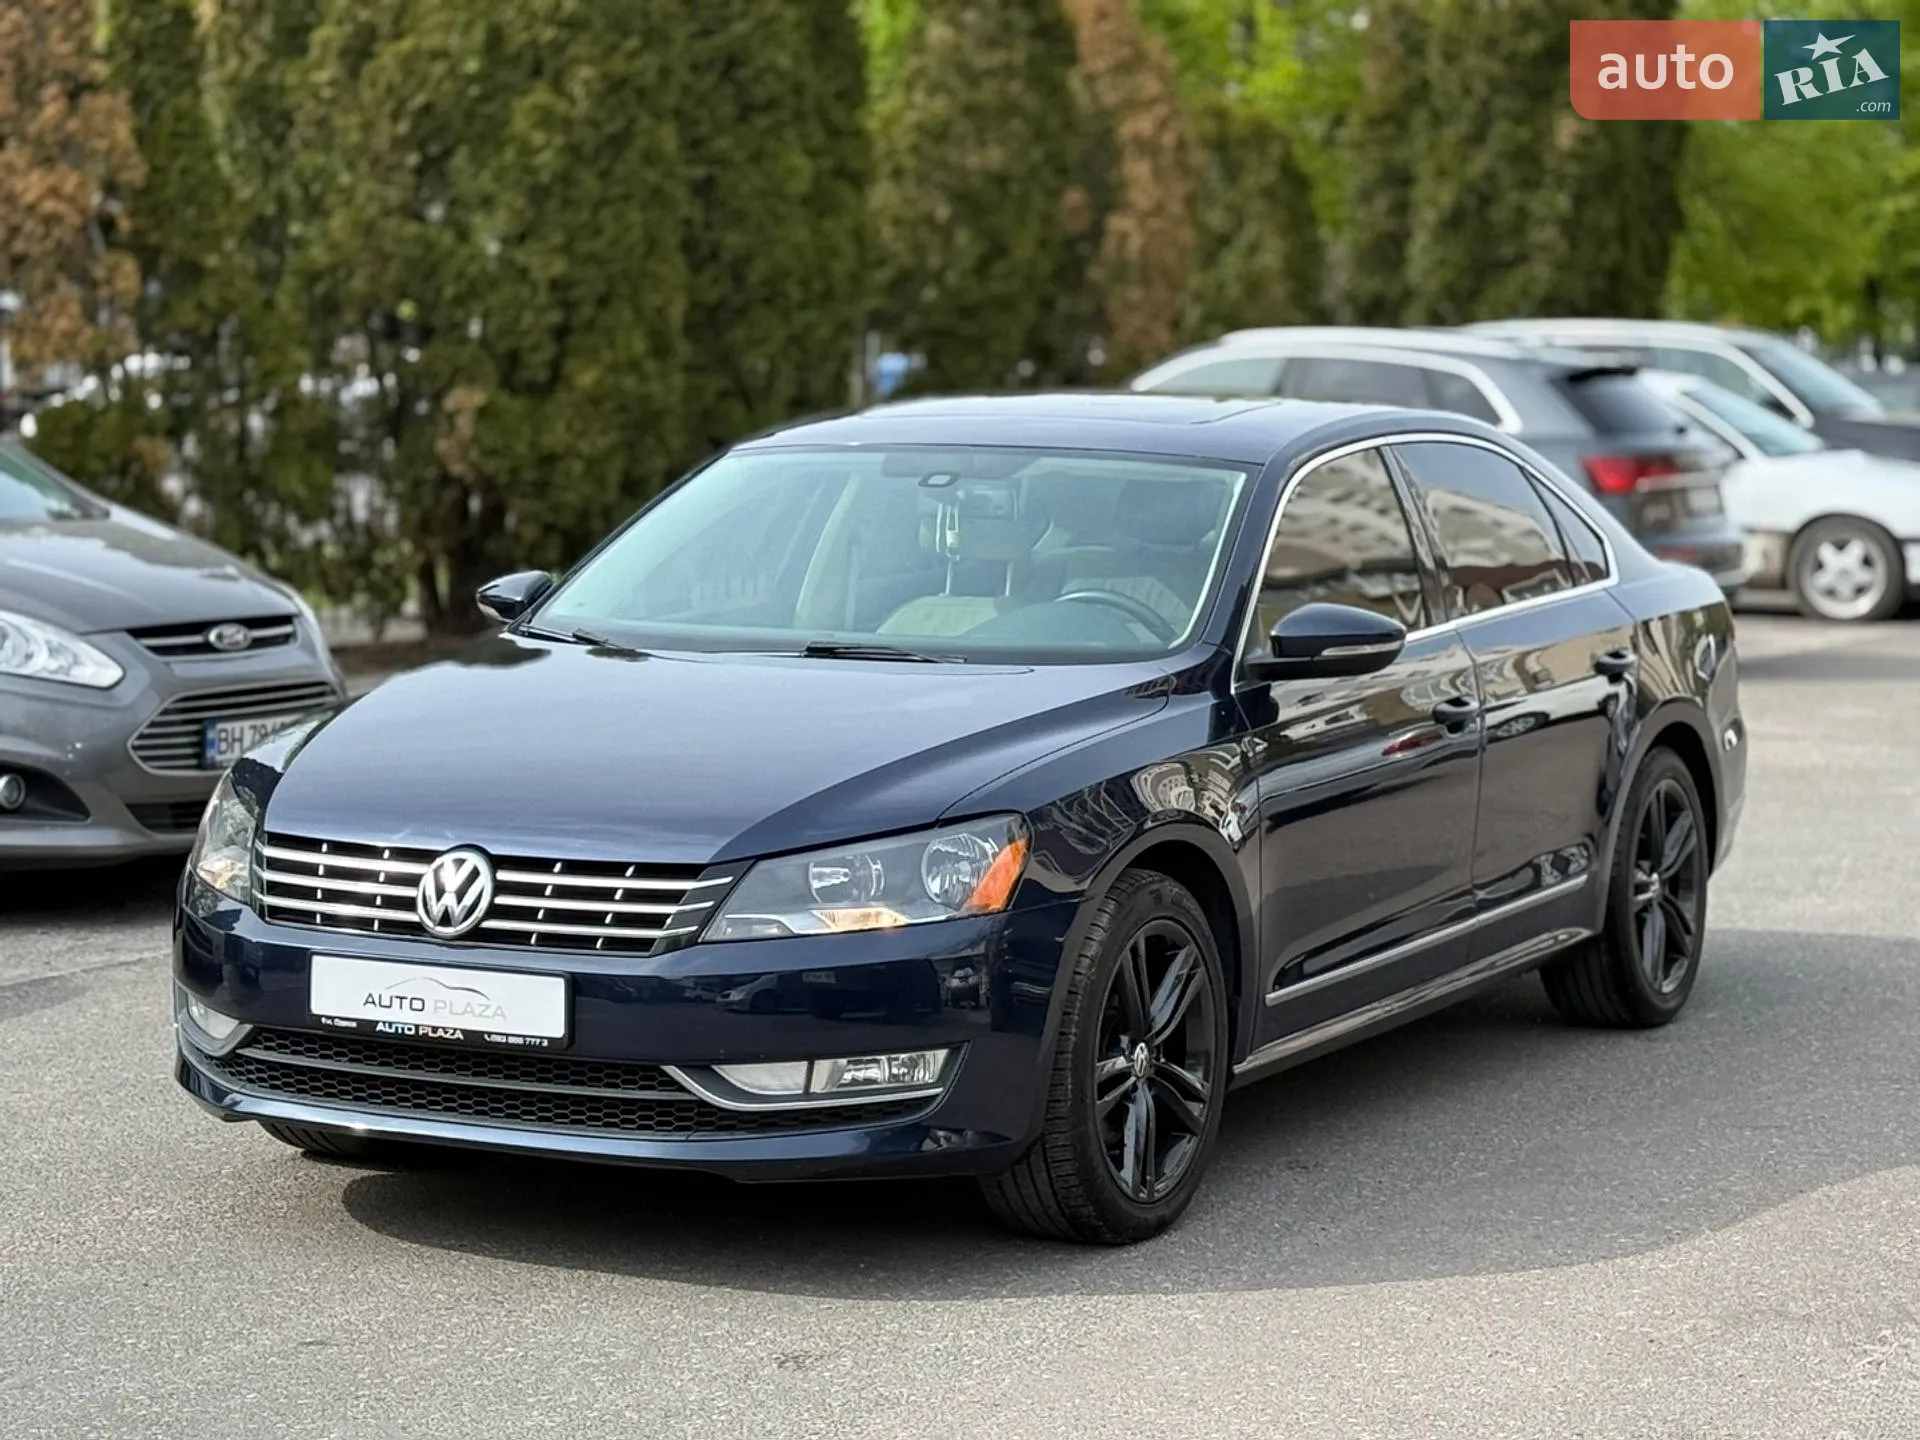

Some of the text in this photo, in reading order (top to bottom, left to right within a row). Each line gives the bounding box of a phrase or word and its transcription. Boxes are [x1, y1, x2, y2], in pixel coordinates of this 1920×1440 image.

[363, 992, 507, 1020] AUTO PLAZA
[376, 1022, 464, 1040] AUTO PLAZA
